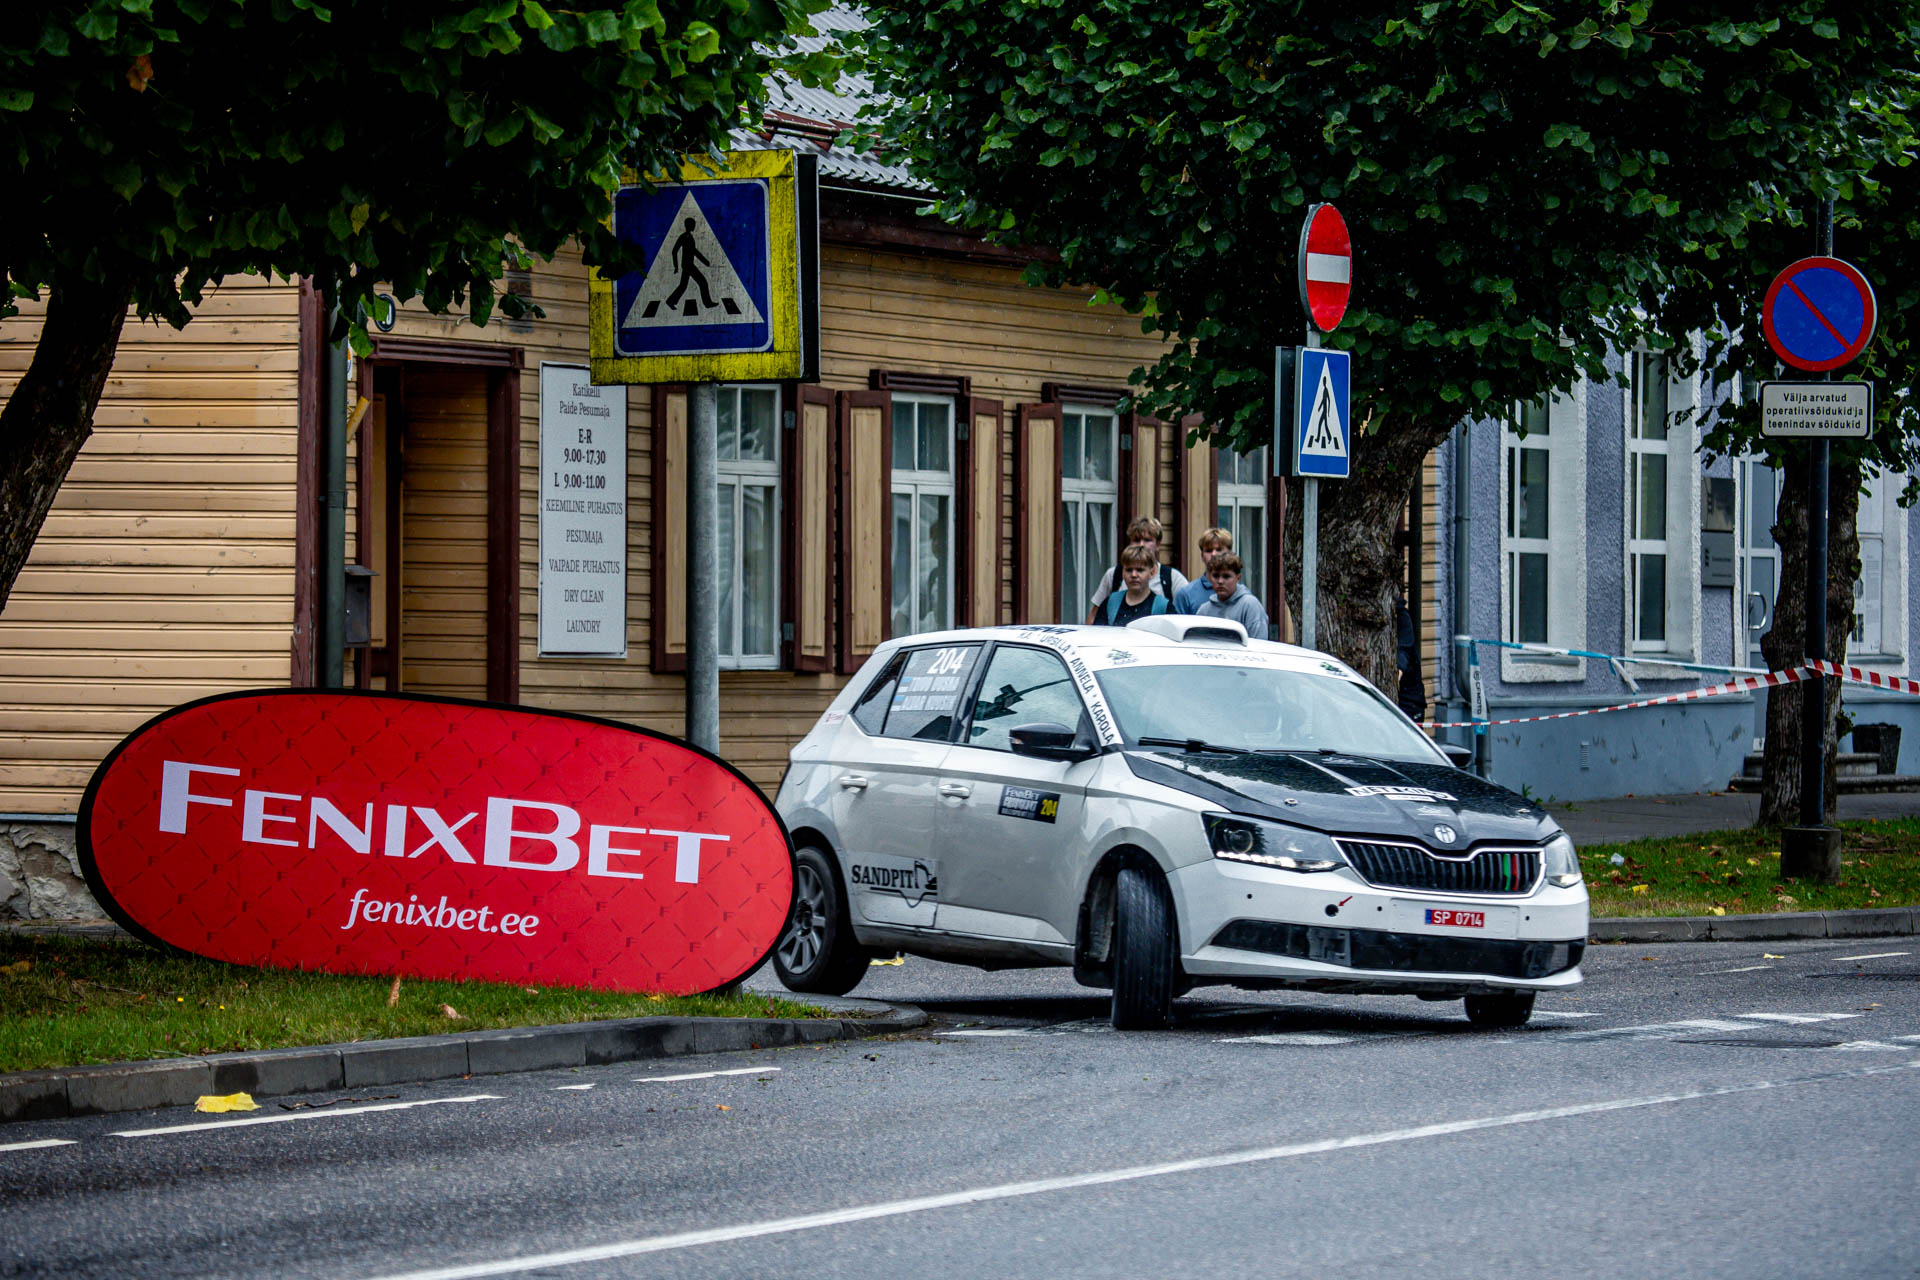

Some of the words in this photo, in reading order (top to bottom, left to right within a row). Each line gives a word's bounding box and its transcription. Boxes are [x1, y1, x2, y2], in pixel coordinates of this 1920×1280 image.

[1783, 393, 1807, 404] Välja
[1809, 393, 1847, 402] arvatud
[559, 401, 578, 415] Paide
[579, 402, 610, 419] Pesumaja
[1766, 406, 1852, 416] operatiivsõidukid
[1854, 407, 1864, 417] ja
[1768, 419, 1816, 429] teenindav
[1818, 420, 1861, 429] sõidukid
[578, 429, 593, 445] E-R
[564, 449, 606, 464] 9.00-17.30
[554, 473, 560, 488] L
[563, 474, 606, 489] 9.00-11.00
[546, 499, 585, 513] KEEMILINE
[587, 501, 623, 515] PUHASTUS
[566, 530, 603, 544] PESUMAJA
[549, 559, 580, 573] VAIPADE
[582, 560, 620, 574] PUHASTUS
[564, 590, 579, 603] DRY
[580, 590, 604, 603] CLEAN
[567, 620, 601, 634] LAUNDRY
[926, 647, 969, 675] 204
[1070, 657, 1095, 694] ANNELA
[1090, 701, 1115, 743] KAROLA
[1040, 799, 1058, 817] 204
[851, 864, 913, 889] SANDPIT
[341, 887, 539, 938] fenixbet.ee
[1433, 911, 1451, 924] SP
[1455, 912, 1483, 926] 0714
